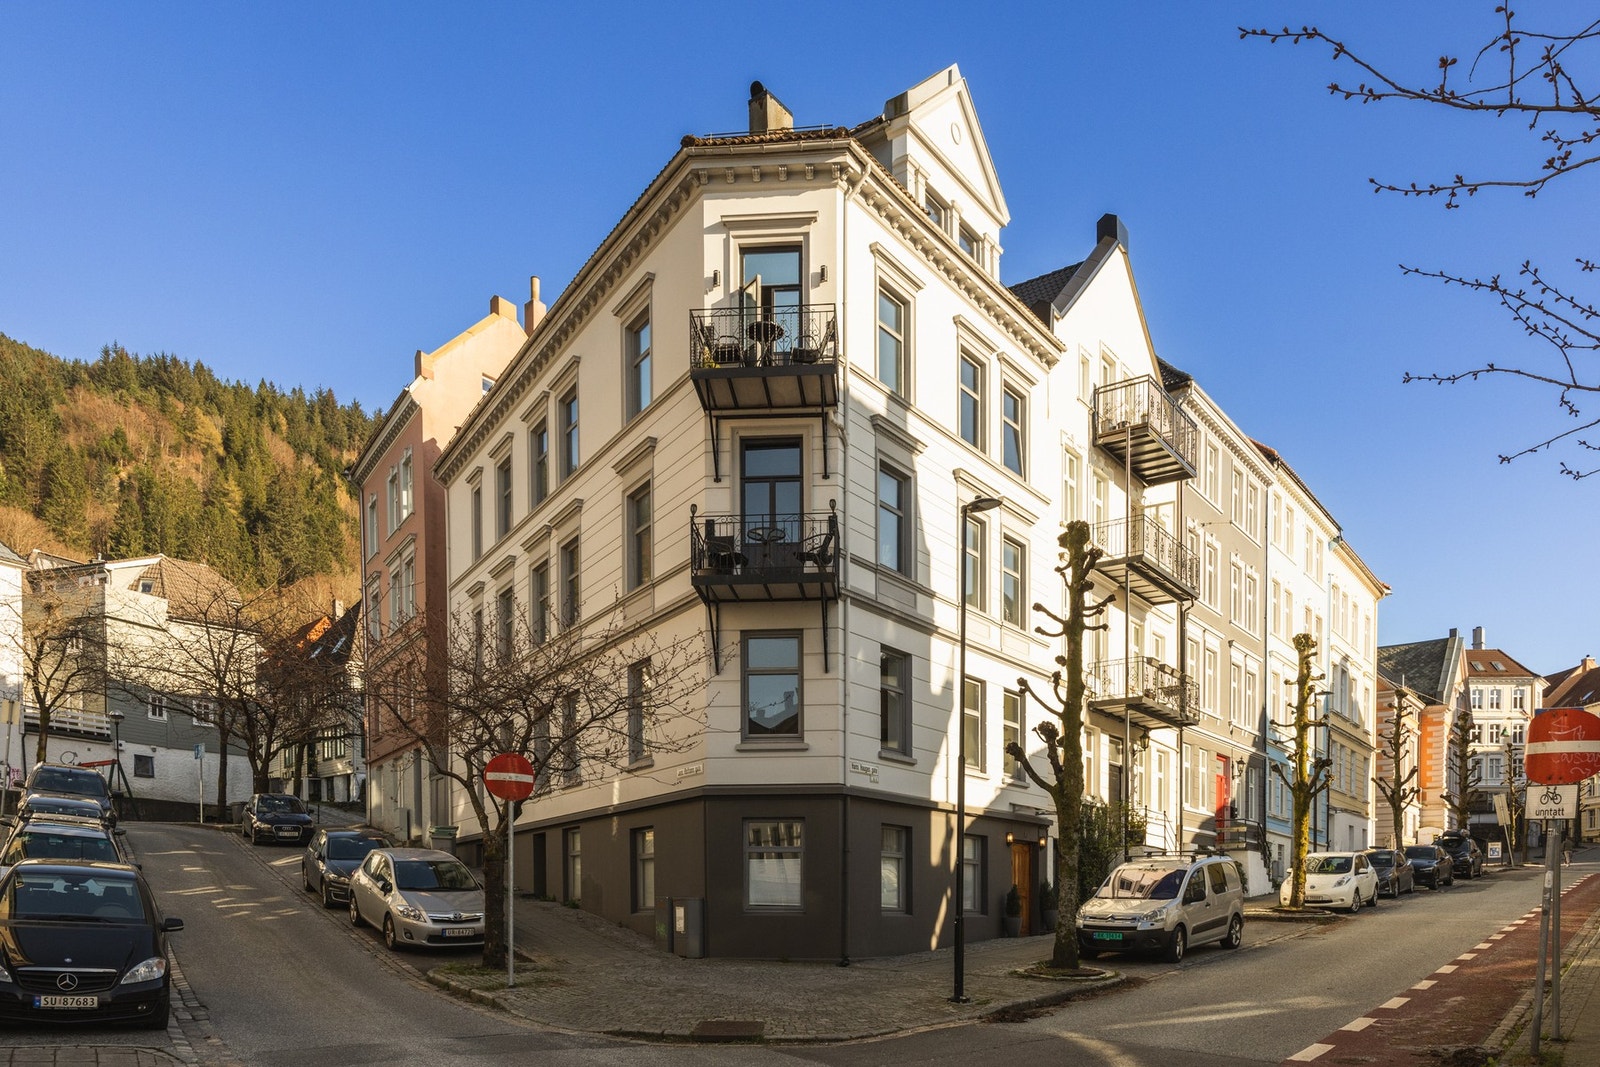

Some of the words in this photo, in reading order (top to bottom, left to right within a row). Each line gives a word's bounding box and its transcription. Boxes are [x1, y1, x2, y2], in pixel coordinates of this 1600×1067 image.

[1535, 808, 1565, 816] unntatt
[43, 997, 57, 1006] SU
[62, 997, 95, 1006] 87683
